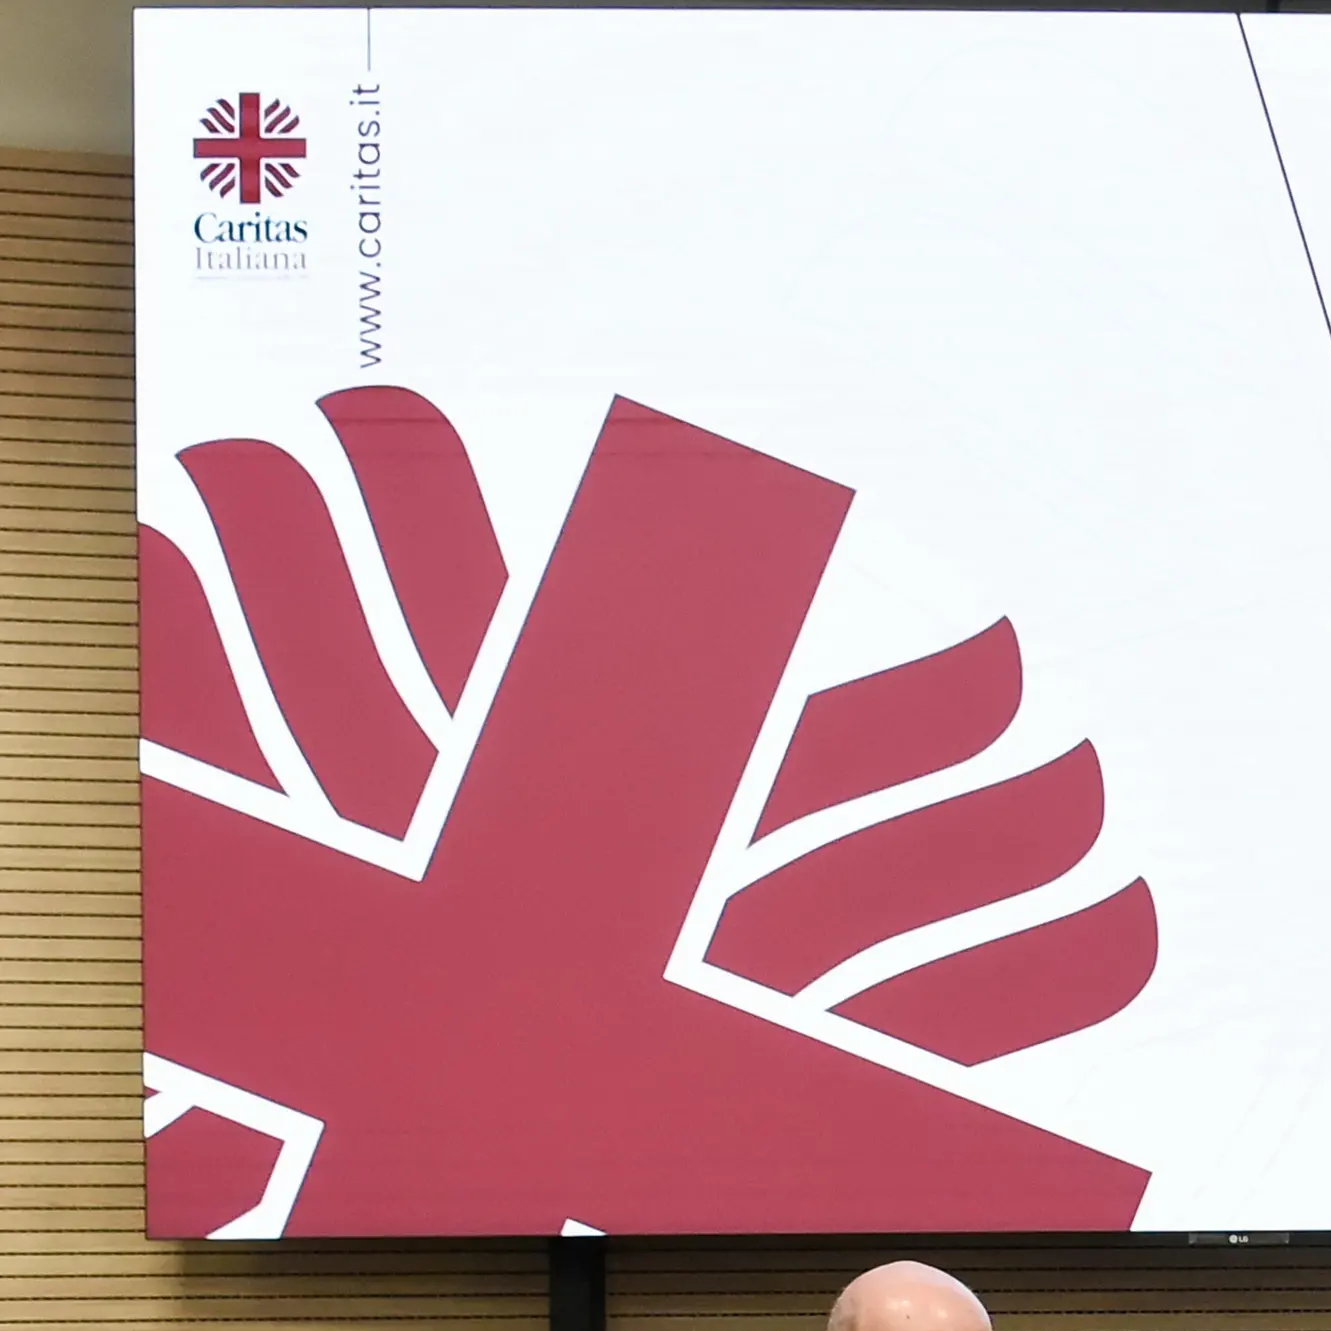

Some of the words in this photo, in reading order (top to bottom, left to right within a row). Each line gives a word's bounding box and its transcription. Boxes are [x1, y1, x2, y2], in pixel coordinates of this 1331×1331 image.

[194, 211, 308, 243] Caritas
[350, 83, 382, 369] www.caritas.it
[196, 246, 306, 270] Italiana
